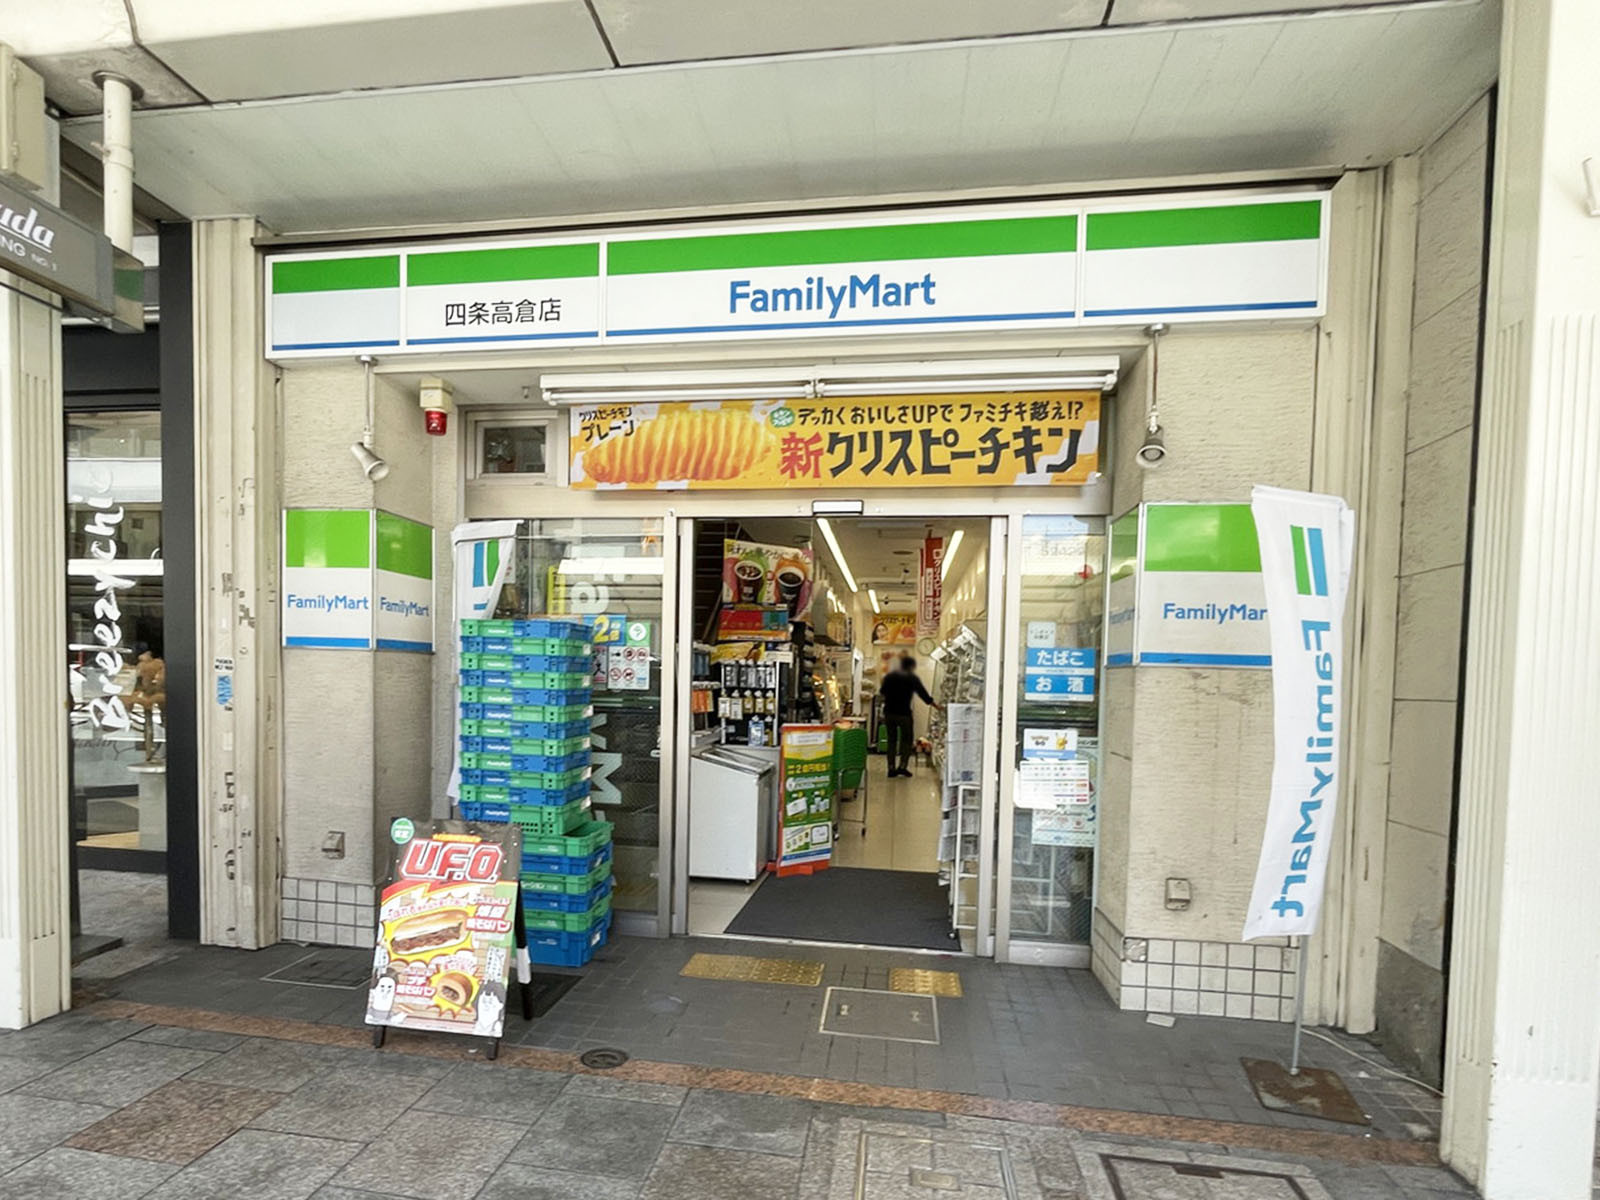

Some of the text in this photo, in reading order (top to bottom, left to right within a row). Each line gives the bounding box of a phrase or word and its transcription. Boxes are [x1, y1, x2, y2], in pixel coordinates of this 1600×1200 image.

[729, 273, 936, 319] FamilyMart
[445, 299, 562, 326] 四条高倉店
[579, 406, 633, 423] クリスピーチキン
[582, 419, 635, 442] プレーン
[780, 426, 1082, 479] 新クリスピーチキン
[287, 594, 369, 612] FamilyMart
[380, 596, 429, 617] FamilyMart
[1163, 602, 1268, 625] FamilyMar
[1037, 650, 1085, 666] たばこ
[402, 840, 503, 883] U.F.O.
